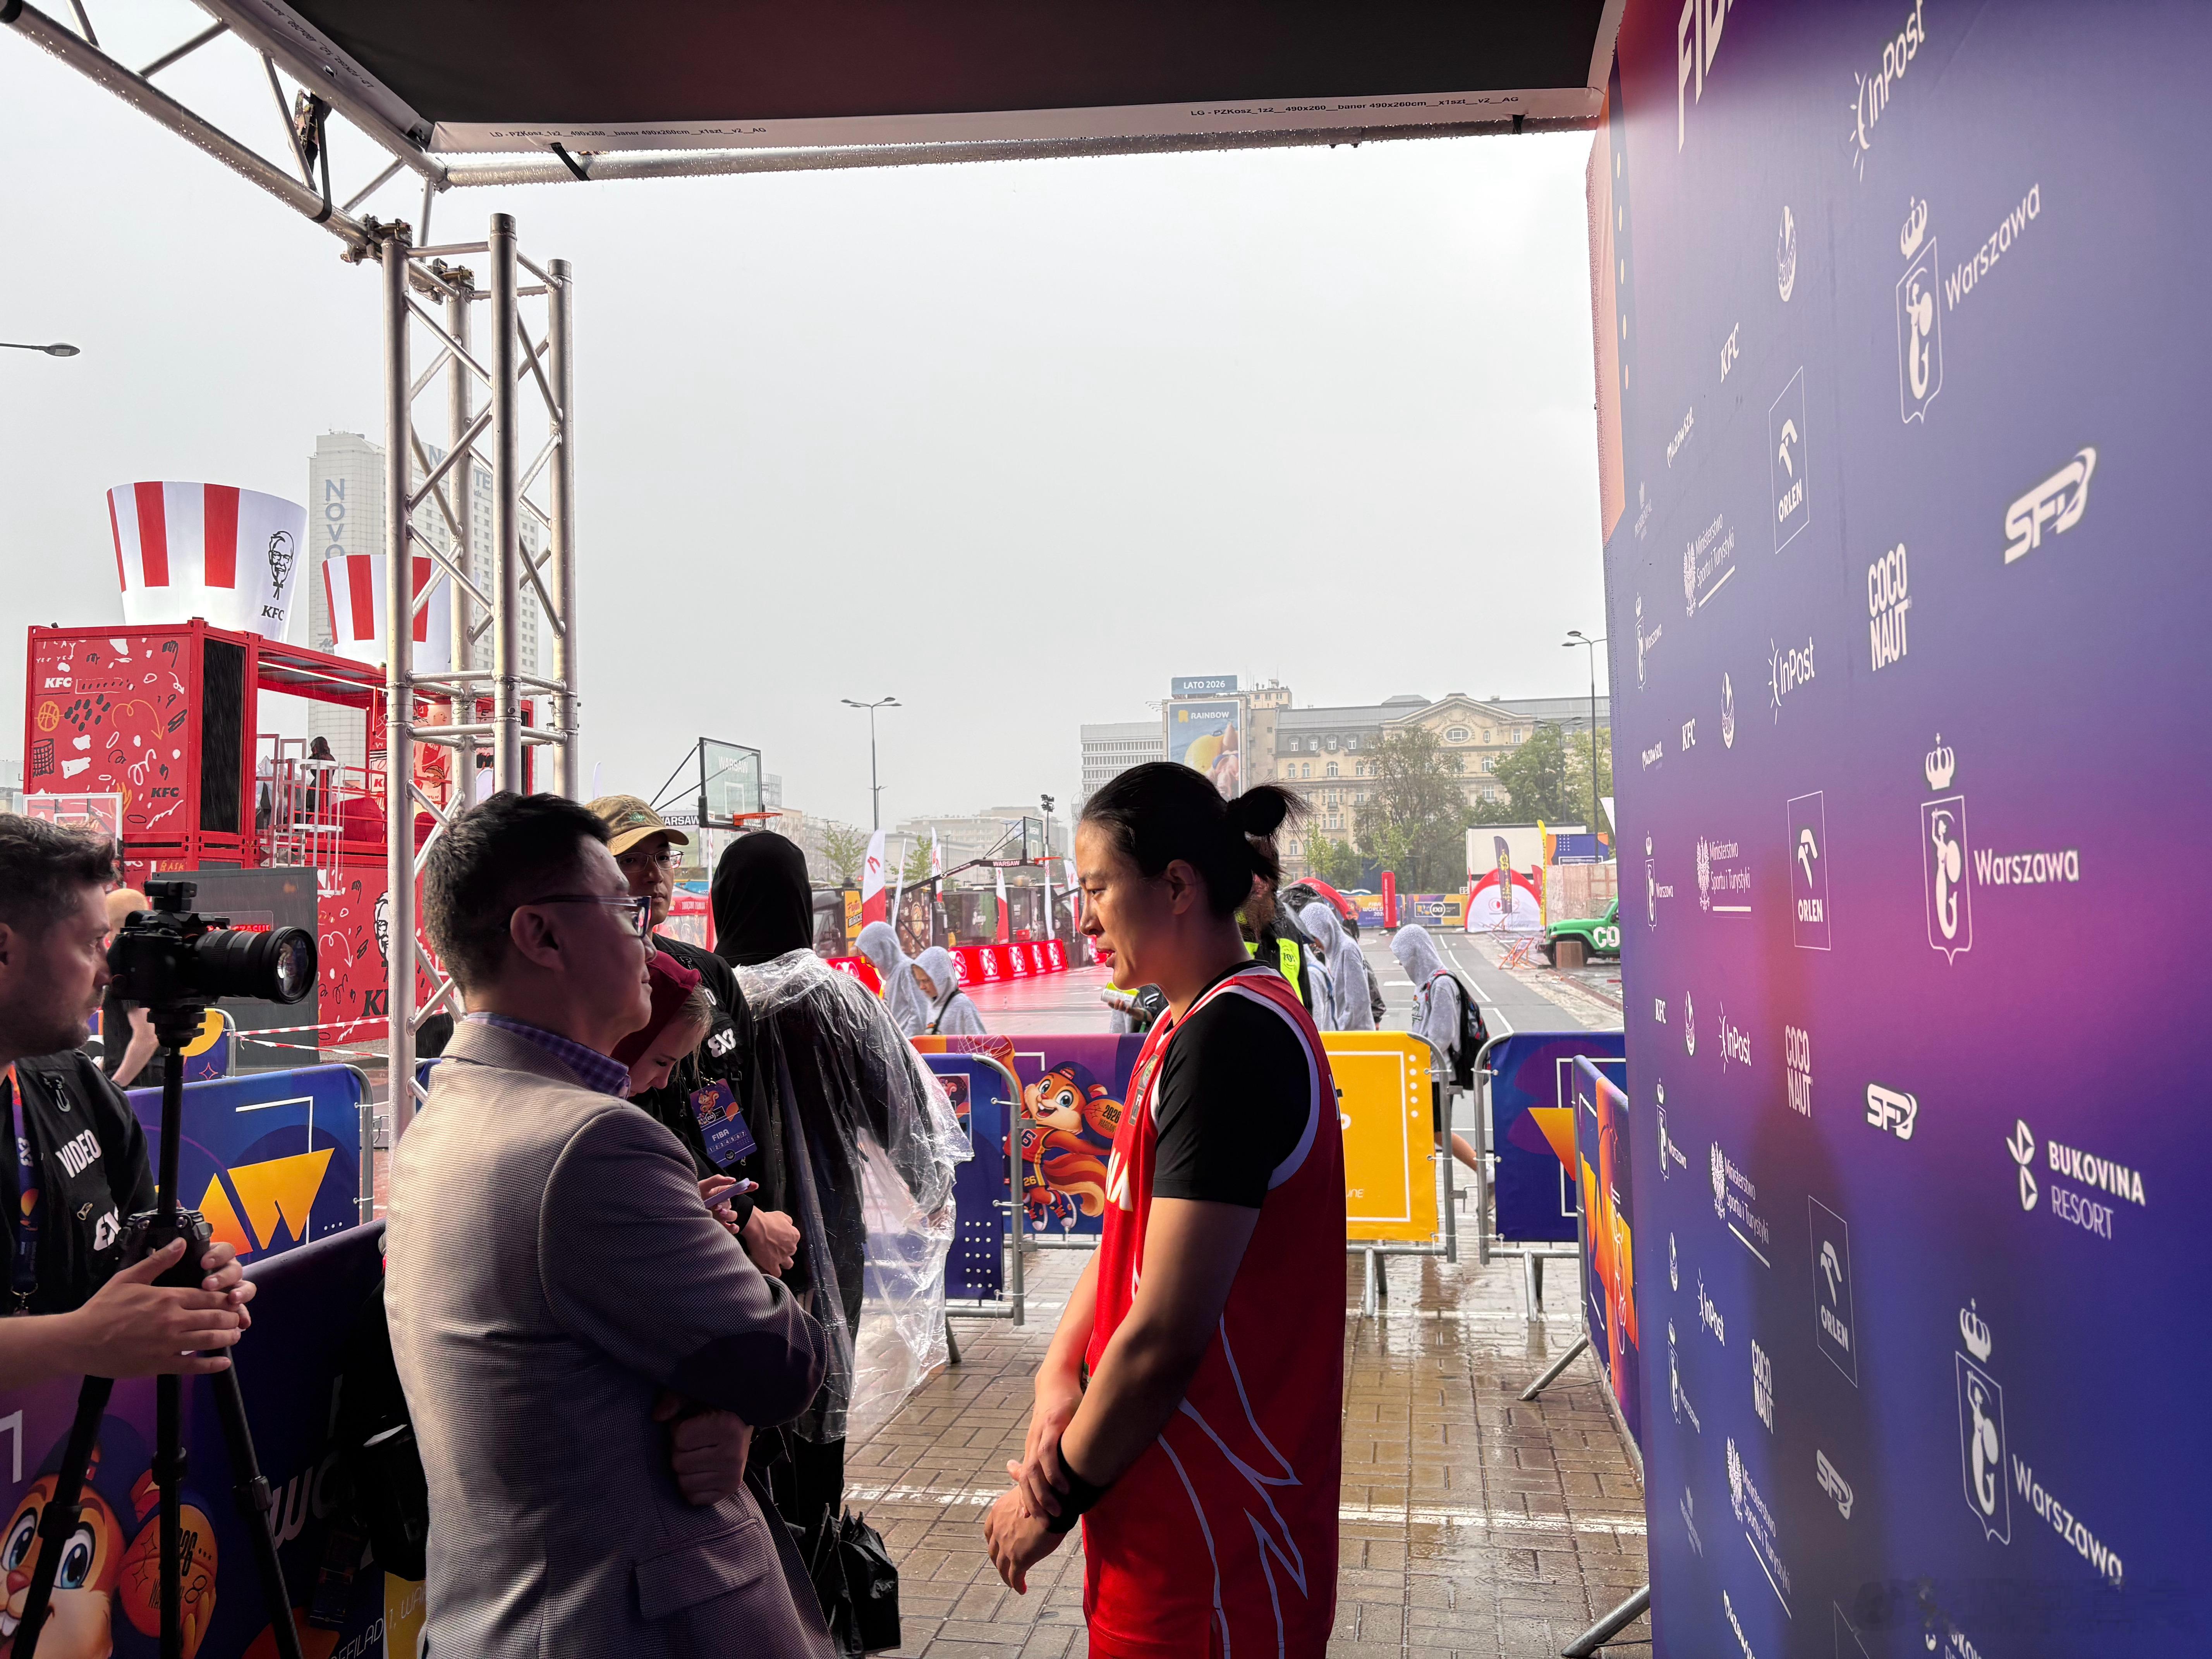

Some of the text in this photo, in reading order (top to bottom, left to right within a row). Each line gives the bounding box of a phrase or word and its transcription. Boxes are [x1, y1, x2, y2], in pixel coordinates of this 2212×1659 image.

[1945, 182, 2040, 311] Warszawa
[1721, 323, 1740, 383] KFC
[1778, 478, 1802, 522] ORLEN
[1696, 514, 1723, 559] Ministerstwo
[1697, 564, 1710, 589] Sportu
[1713, 526, 1735, 568] Turystyki
[1868, 543, 1908, 618] COCO
[261, 605, 285, 621] KFC
[1870, 598, 1909, 672] NAUT
[1645, 623, 1662, 652] Warszawa
[44, 677, 72, 688] KFC
[1183, 680, 1225, 689] LATO 2026
[1779, 636, 1815, 696] InPost
[1191, 711, 1230, 720] RAINBOW
[1682, 718, 1696, 751] KFC
[718, 756, 748, 774] WARSAW
[151, 787, 179, 798] KFC
[1709, 839, 1739, 861] Ministerstwo
[1974, 848, 2079, 886] Warszawa
[1656, 883, 1673, 898] Warszawa
[1711, 871, 1725, 895] Sportu
[1728, 867, 1751, 894] Turystyki
[1798, 899, 1823, 922] ORLEN
[1655, 998, 1666, 1024] KFC
[1727, 1024, 1752, 1066] InPost
[1785, 1025, 1810, 1074] COCO
[1787, 1067, 1811, 1118] NAUT
[55, 1129, 101, 1178] VIDEO
[711, 1128, 730, 1142] FIBA
[1668, 1137, 1687, 1170] Warszawa
[1023, 1176, 1037, 1187] 26
[1724, 1156, 1756, 1201] Ministerstwo
[2048, 1140, 2146, 1207] BUKOVINA
[1726, 1186, 1741, 1219] Sportu
[1744, 1202, 1769, 1245] Turystyki
[2051, 1185, 2114, 1240] RESORT
[1704, 1292, 1725, 1347] InPost
[1820, 1305, 1849, 1352] ORLEN
[1752, 1339, 1772, 1396] COCO
[1680, 1384, 1700, 1434] Warszawa
[1753, 1375, 1773, 1435] NAUT
[1742, 1463, 1776, 1538] Ministerstwo
[2013, 1453, 2123, 1586] Warszawa
[1744, 1495, 1761, 1542] Sportu
[1764, 1529, 1791, 1595] Turystyki
[330, 1618, 384, 1659] EFILAD
